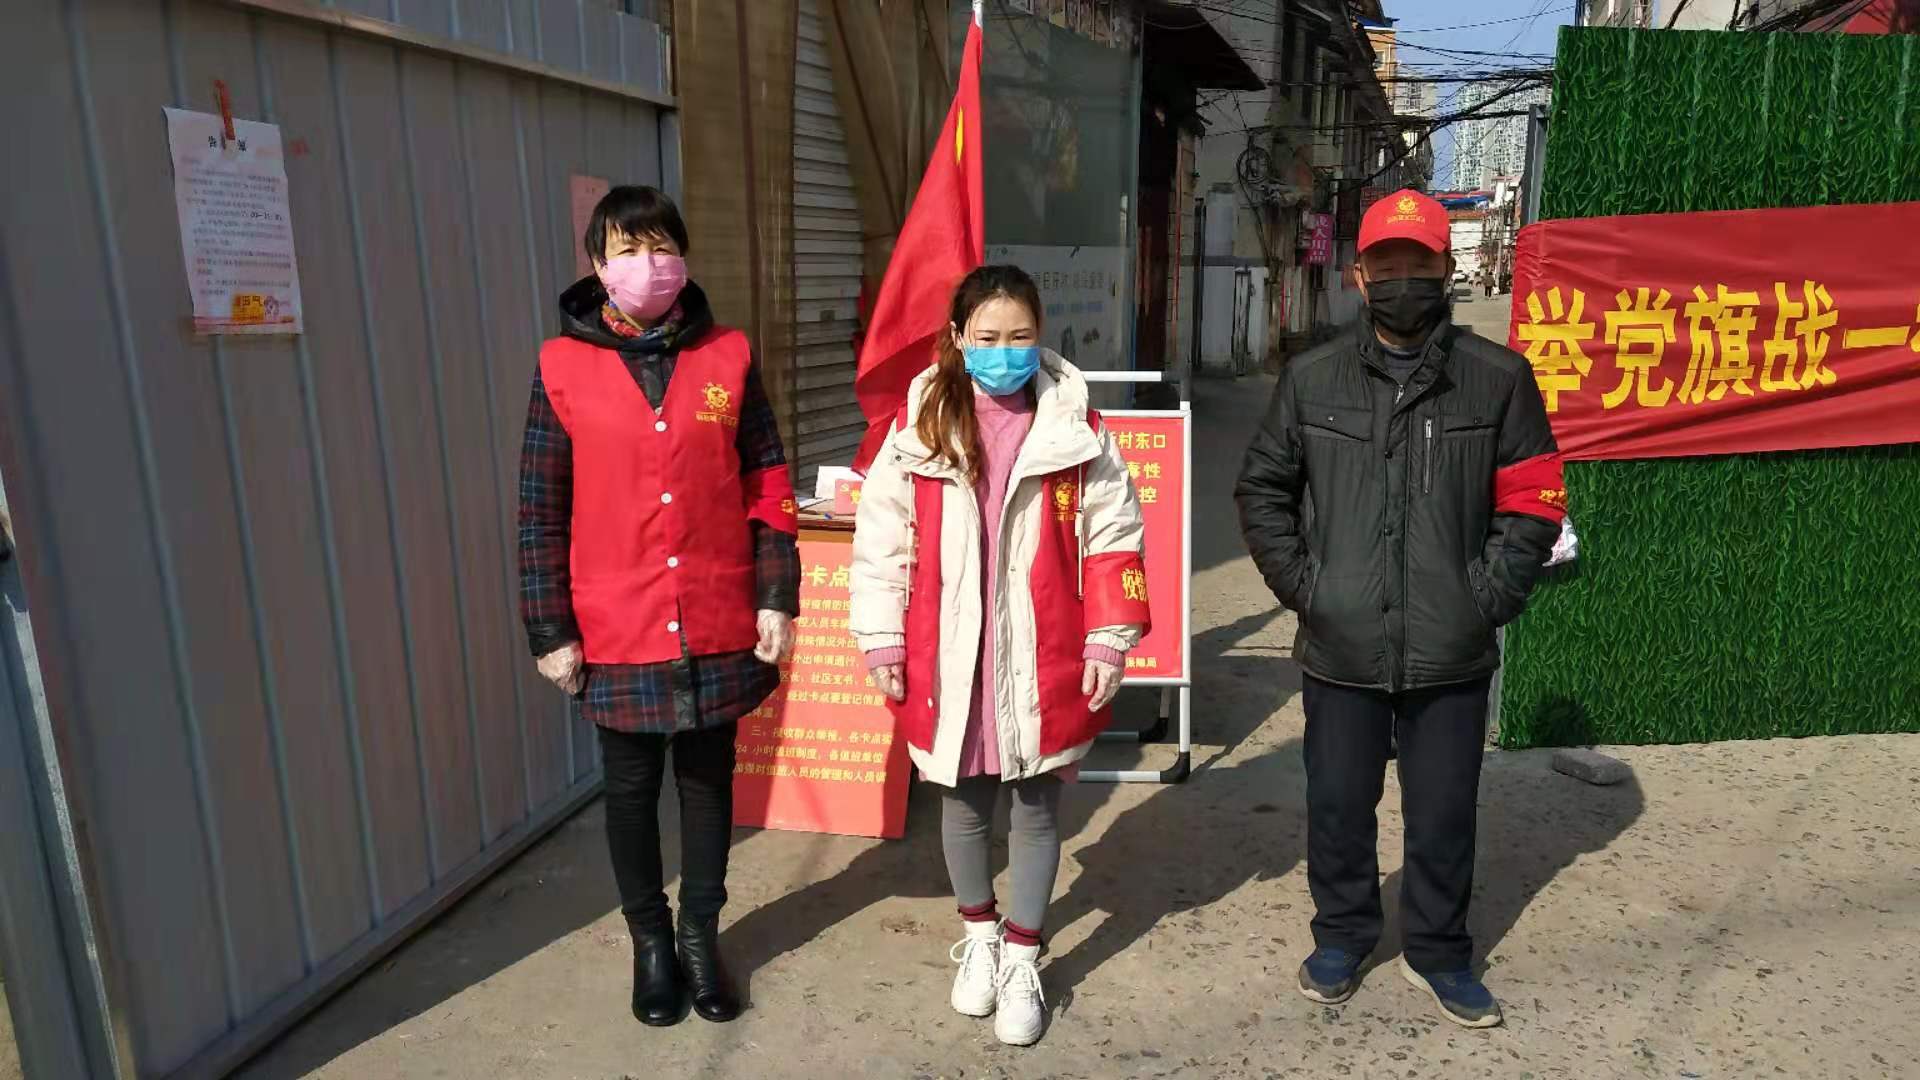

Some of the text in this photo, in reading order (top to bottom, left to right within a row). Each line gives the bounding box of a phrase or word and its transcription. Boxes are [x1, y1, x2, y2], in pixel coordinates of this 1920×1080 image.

[1517, 279, 1920, 412] 举党旗战一
[1138, 485, 1158, 503] 控
[801, 565, 850, 587] 卡点
